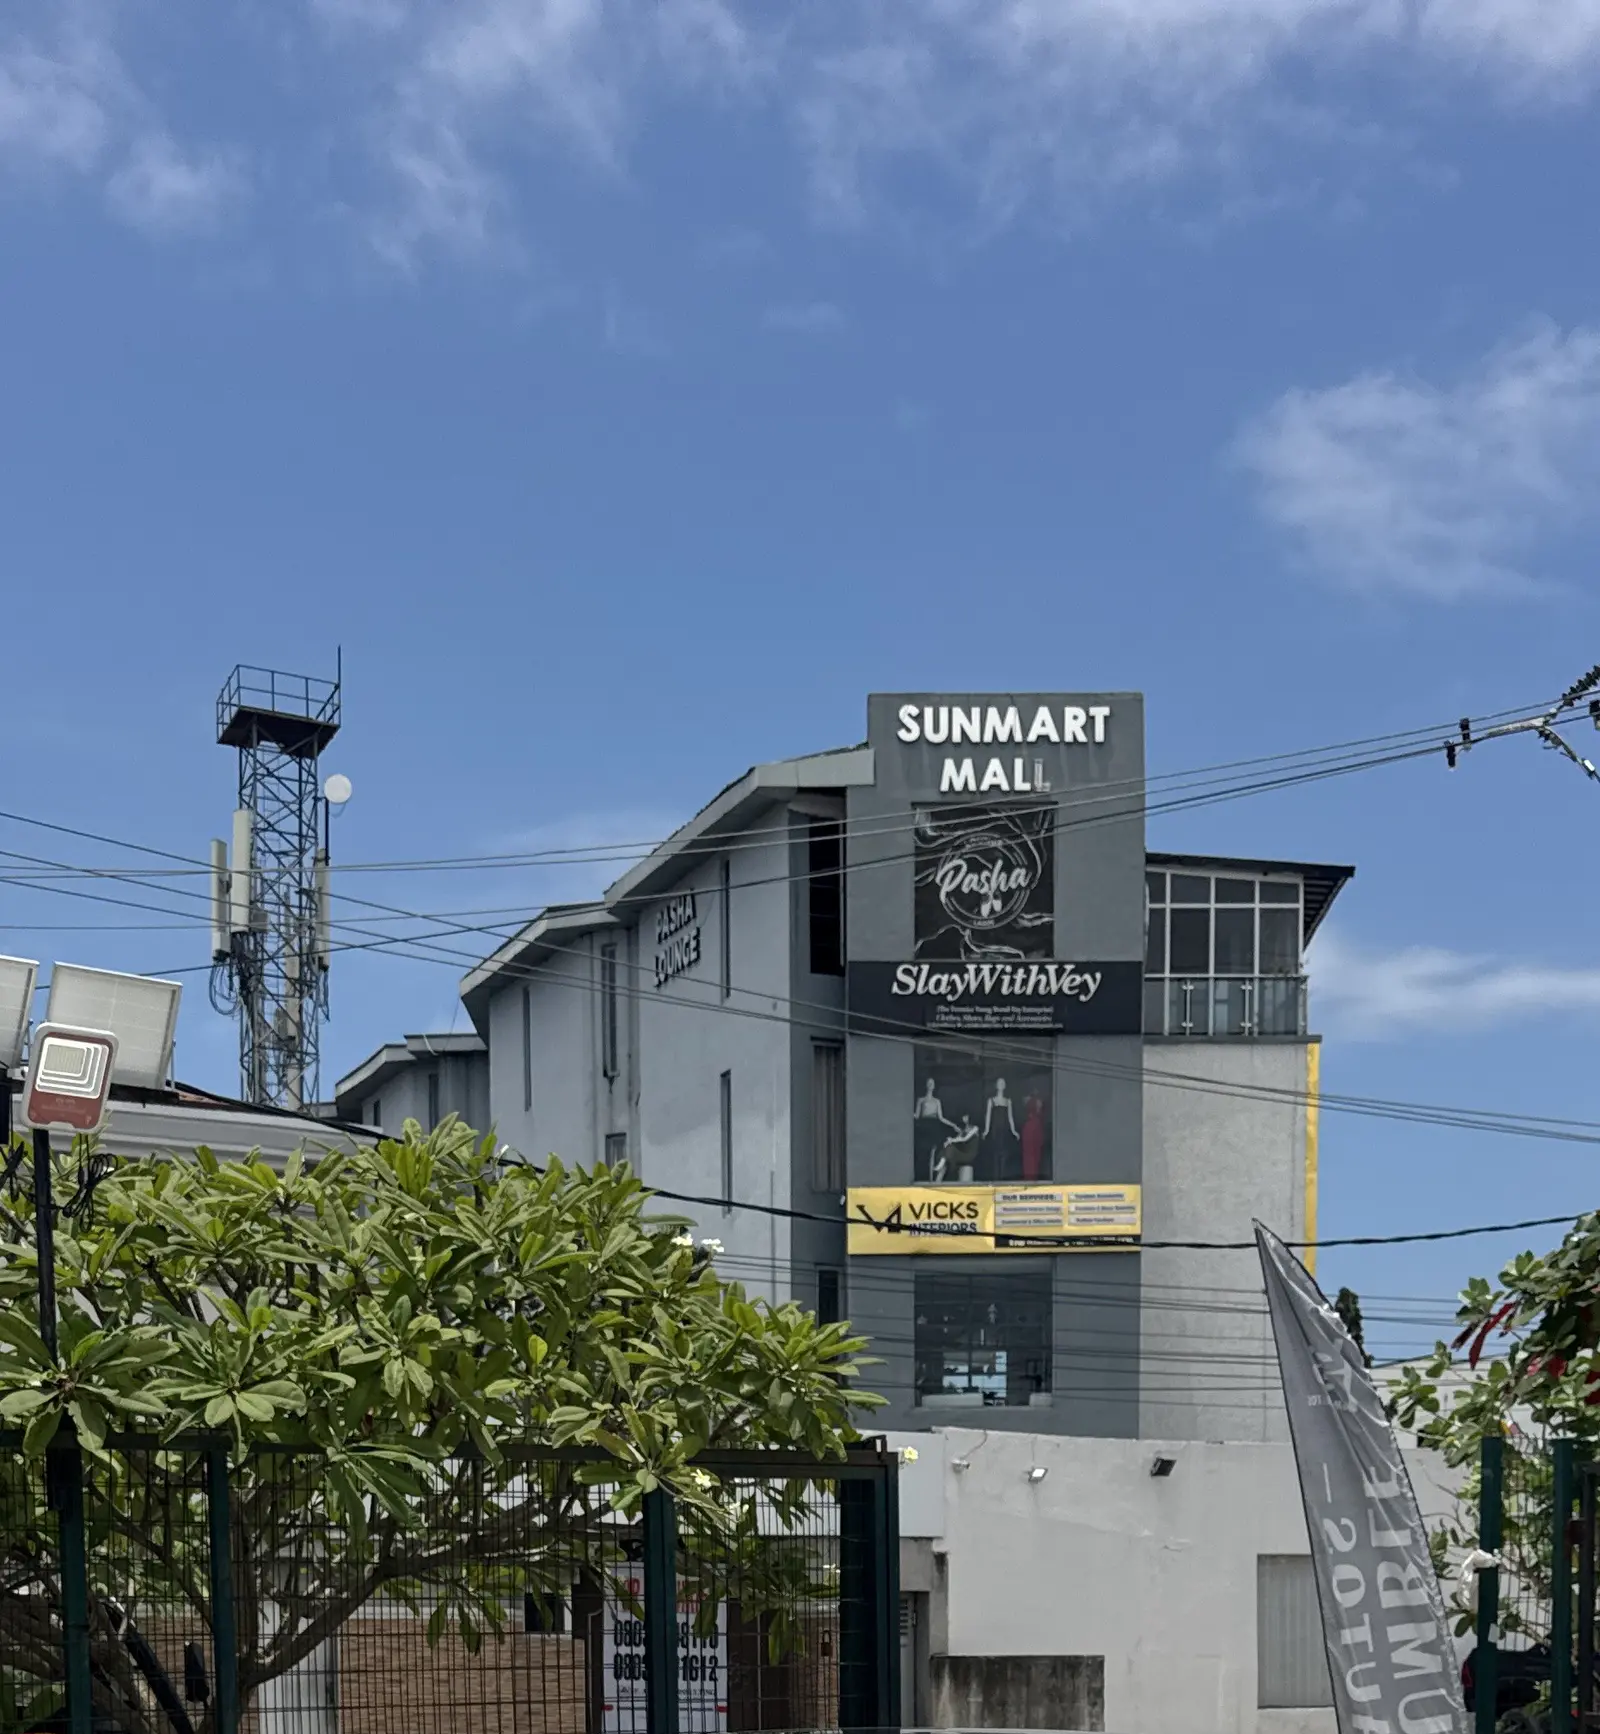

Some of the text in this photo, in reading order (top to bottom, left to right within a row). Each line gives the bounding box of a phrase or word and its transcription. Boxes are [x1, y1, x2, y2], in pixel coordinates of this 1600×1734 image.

[897, 704, 1111, 743] SUNMART
[939, 757, 1050, 792] MALL
[935, 858, 1033, 904] Pasha
[656, 889, 697, 944] PASHA
[654, 927, 701, 988] LOUNGE
[891, 964, 1102, 1002] SlayWithVey
[908, 1201, 979, 1220] VICKS
